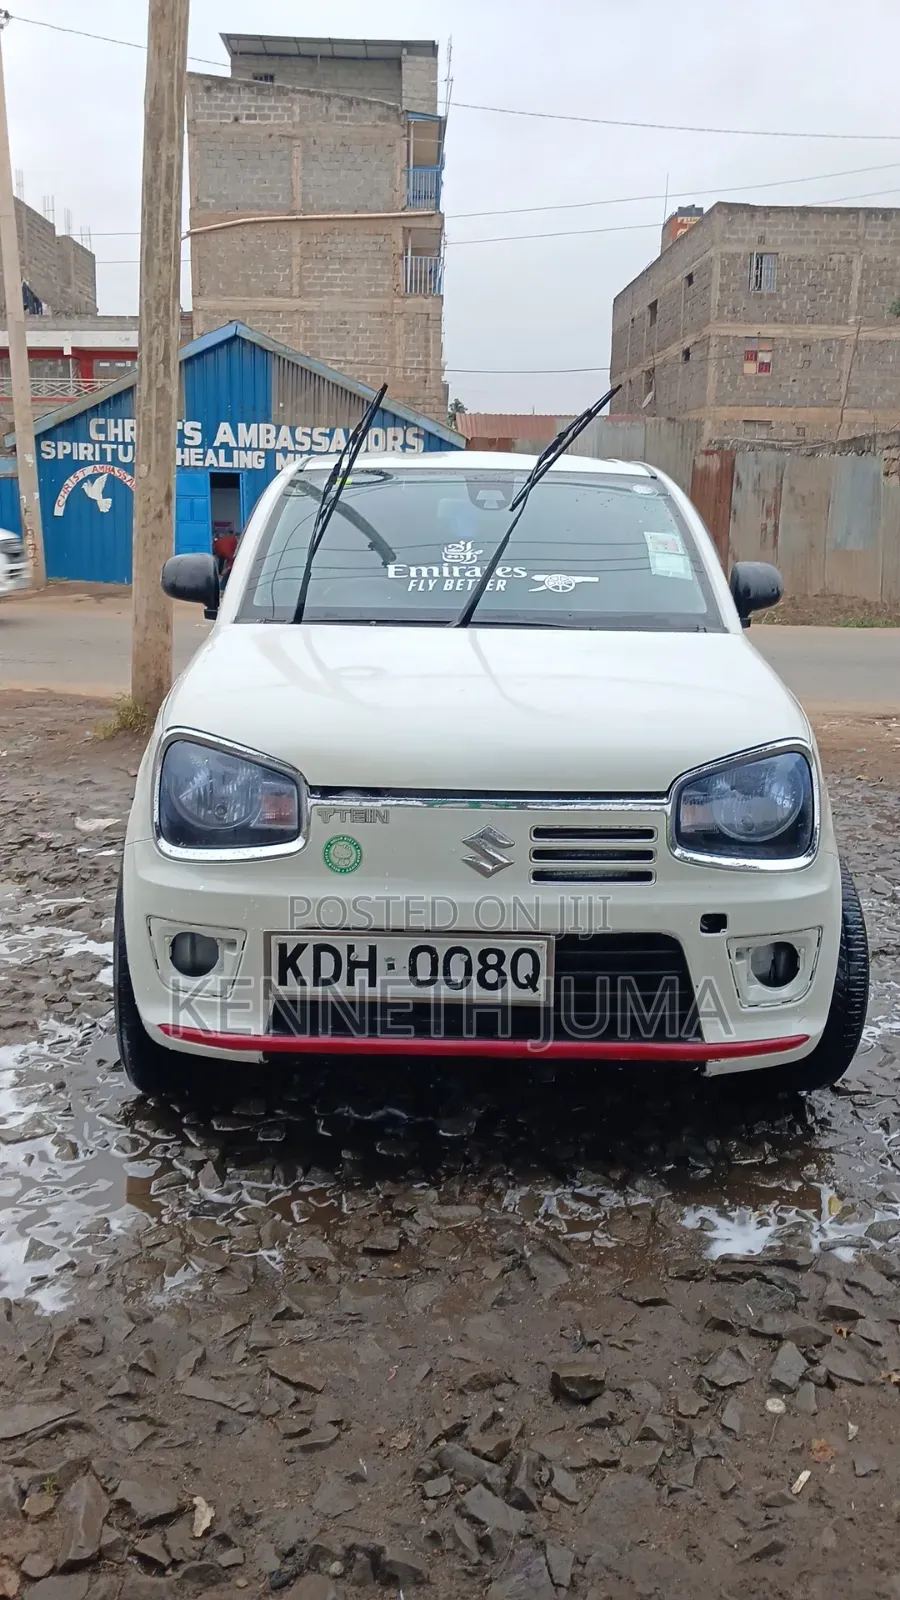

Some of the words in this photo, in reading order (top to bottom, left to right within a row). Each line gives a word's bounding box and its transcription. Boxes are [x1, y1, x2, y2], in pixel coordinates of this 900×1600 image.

[40, 440, 136, 463] SPIRITU
[176, 447, 266, 469] HEALING
[57, 468, 87, 508] CHRIST
[91, 465, 137, 491] AMBASSA
[387, 563, 527, 579] Emiraes
[407, 579, 438, 592] FLY
[443, 579, 507, 592] BETER
[277, 942, 377, 988] KDH
[408, 943, 541, 994] 008Q
